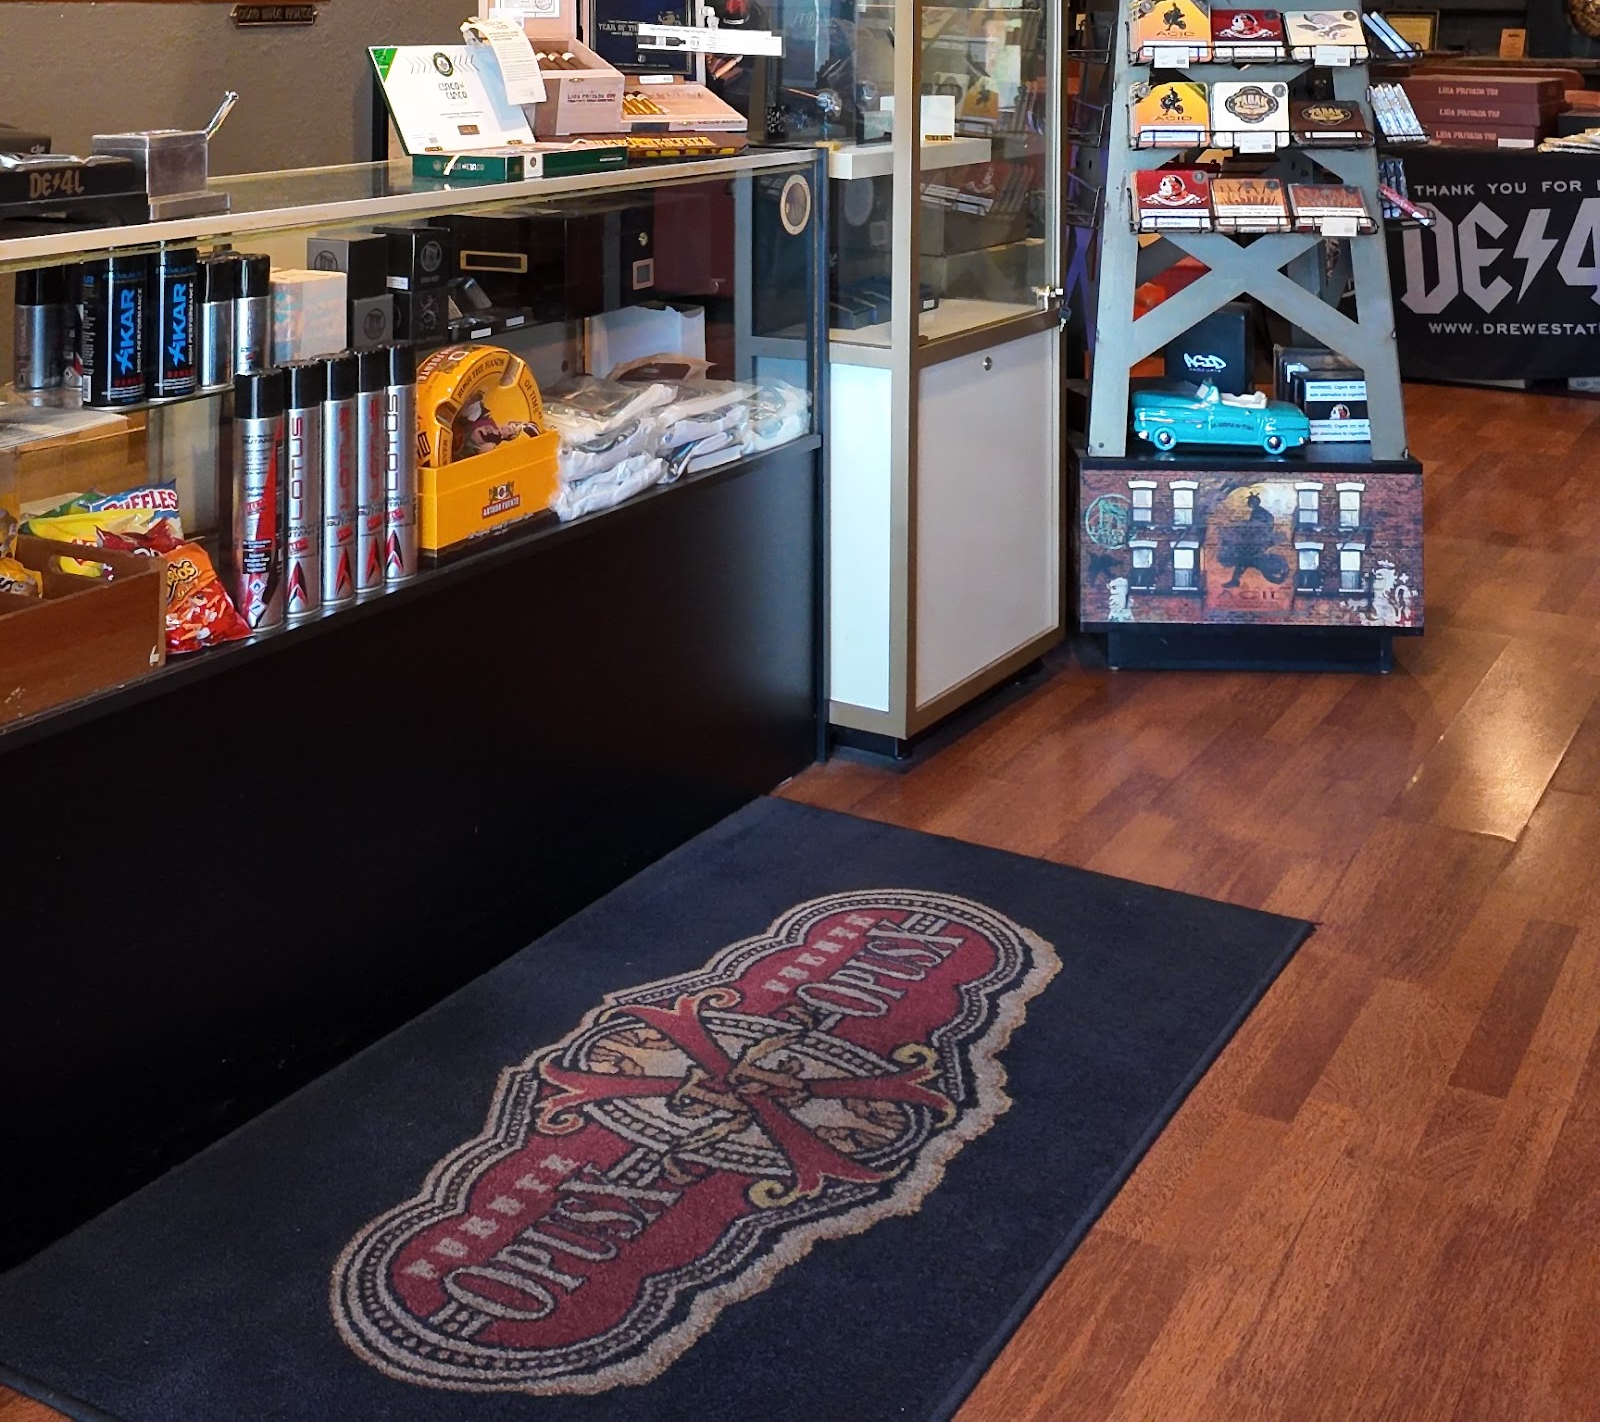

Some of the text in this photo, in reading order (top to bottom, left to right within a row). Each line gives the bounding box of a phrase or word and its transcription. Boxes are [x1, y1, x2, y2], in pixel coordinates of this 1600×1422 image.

[1414, 180, 1582, 197] THANK YOU FOR
[291, 417, 303, 521] LOTUS
[339, 407, 350, 511] LOTUS
[387, 394, 398, 491] LOTUS
